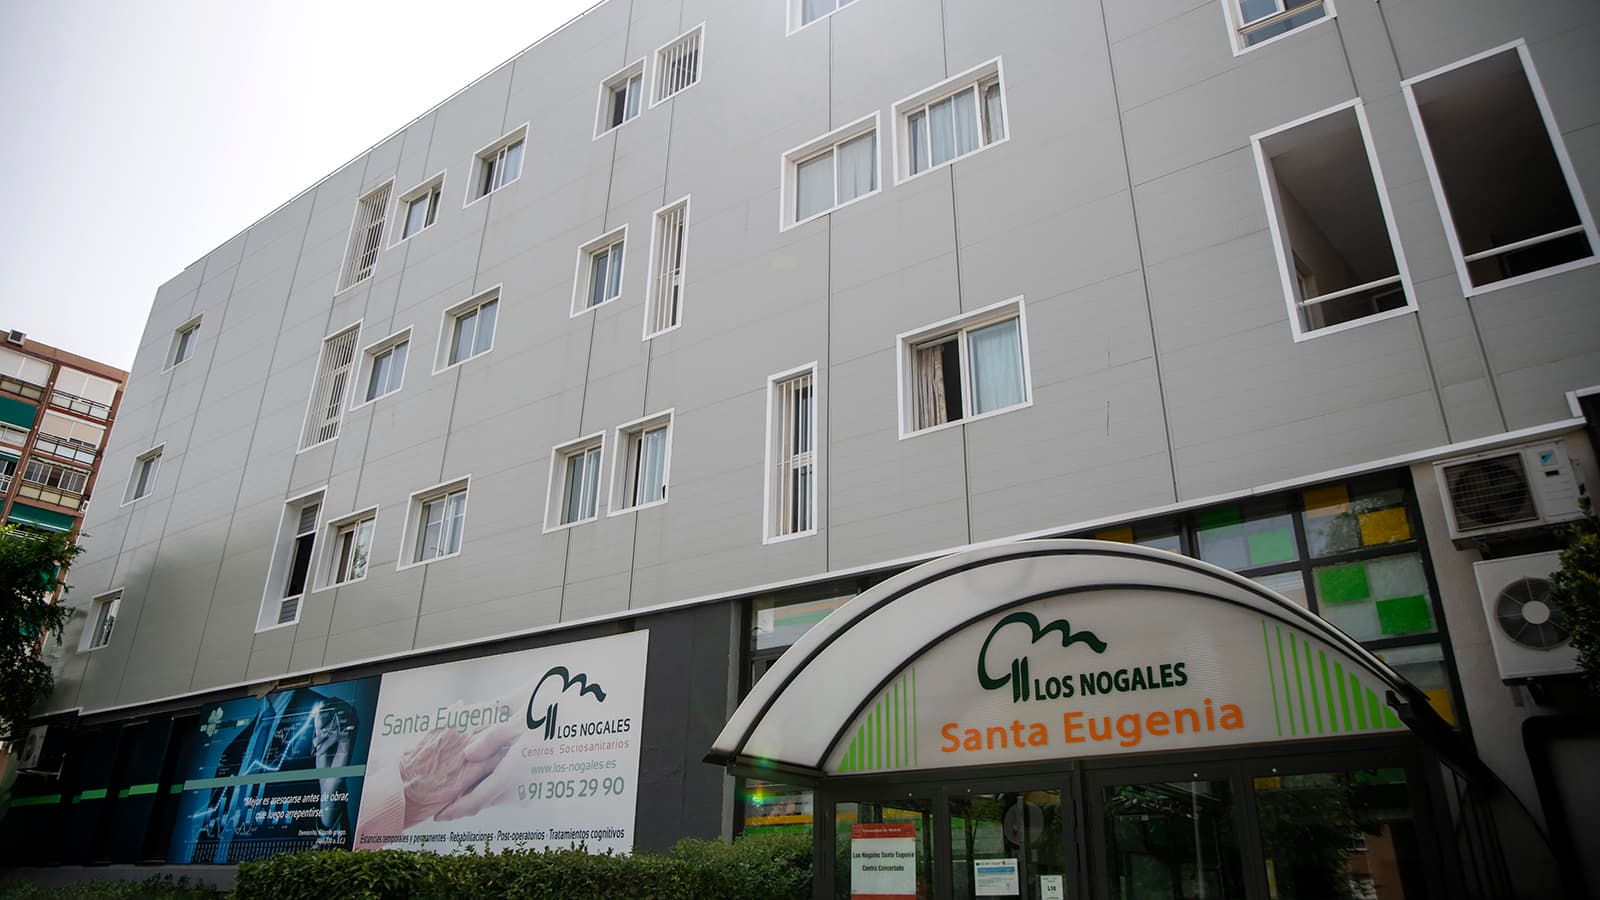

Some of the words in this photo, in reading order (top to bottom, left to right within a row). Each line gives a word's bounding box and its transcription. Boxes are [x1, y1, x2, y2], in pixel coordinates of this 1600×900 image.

[1035, 675, 1073, 700] LOS
[1080, 662, 1188, 696] NOGALES
[382, 713, 430, 736] Santa
[435, 700, 511, 734] Eugenia
[557, 724, 577, 739] LOS
[580, 718, 631, 737] NOGALES
[941, 719, 1048, 753] Santa
[1063, 698, 1245, 748] Eugenia
[521, 747, 554, 758] Centros
[559, 740, 629, 754] Sociosanitarios
[531, 759, 617, 775] www.los-nogales.es
[528, 782, 542, 800] 91
[545, 780, 575, 799] 305
[578, 778, 598, 797] 29
[602, 776, 624, 796] 90
[450, 831, 494, 843] Rehabilitaciones
[497, 829, 545, 842] Post-operatorios
[549, 828, 590, 840] Tratamientos
[590, 827, 625, 842] cognitivos
